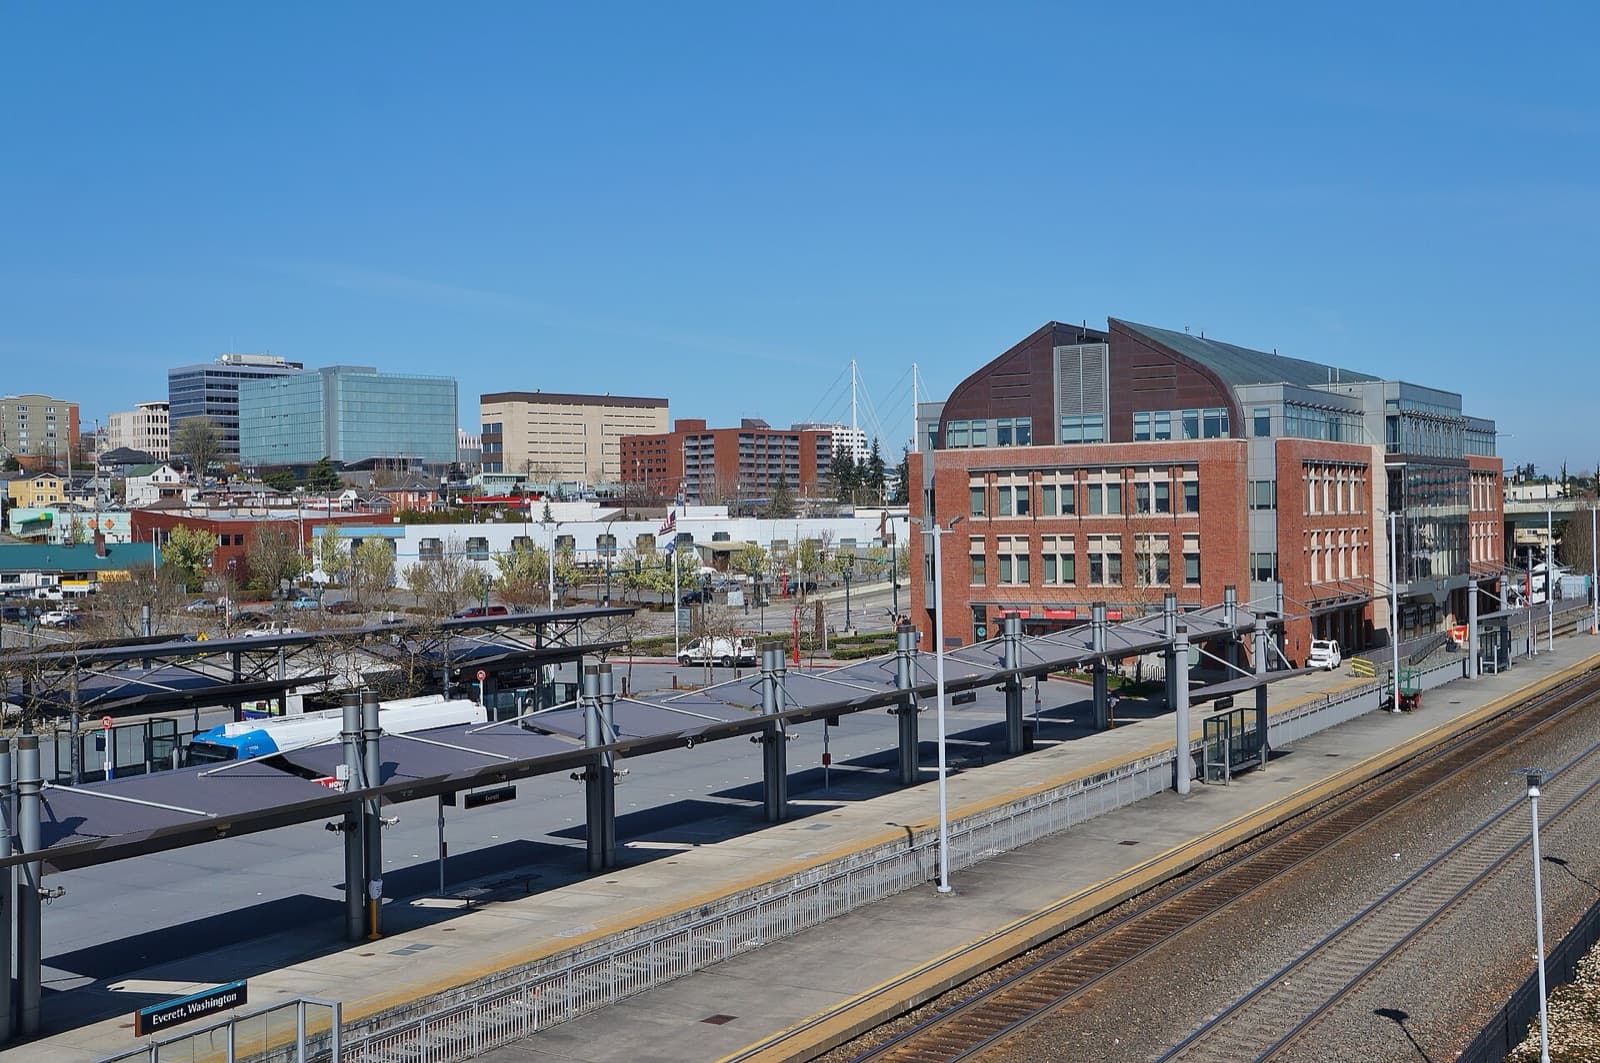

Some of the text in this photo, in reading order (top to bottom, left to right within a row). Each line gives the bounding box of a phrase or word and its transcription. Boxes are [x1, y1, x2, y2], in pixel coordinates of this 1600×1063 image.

[687, 739, 692, 748] 2
[152, 993, 237, 1025] Everett, Washington
